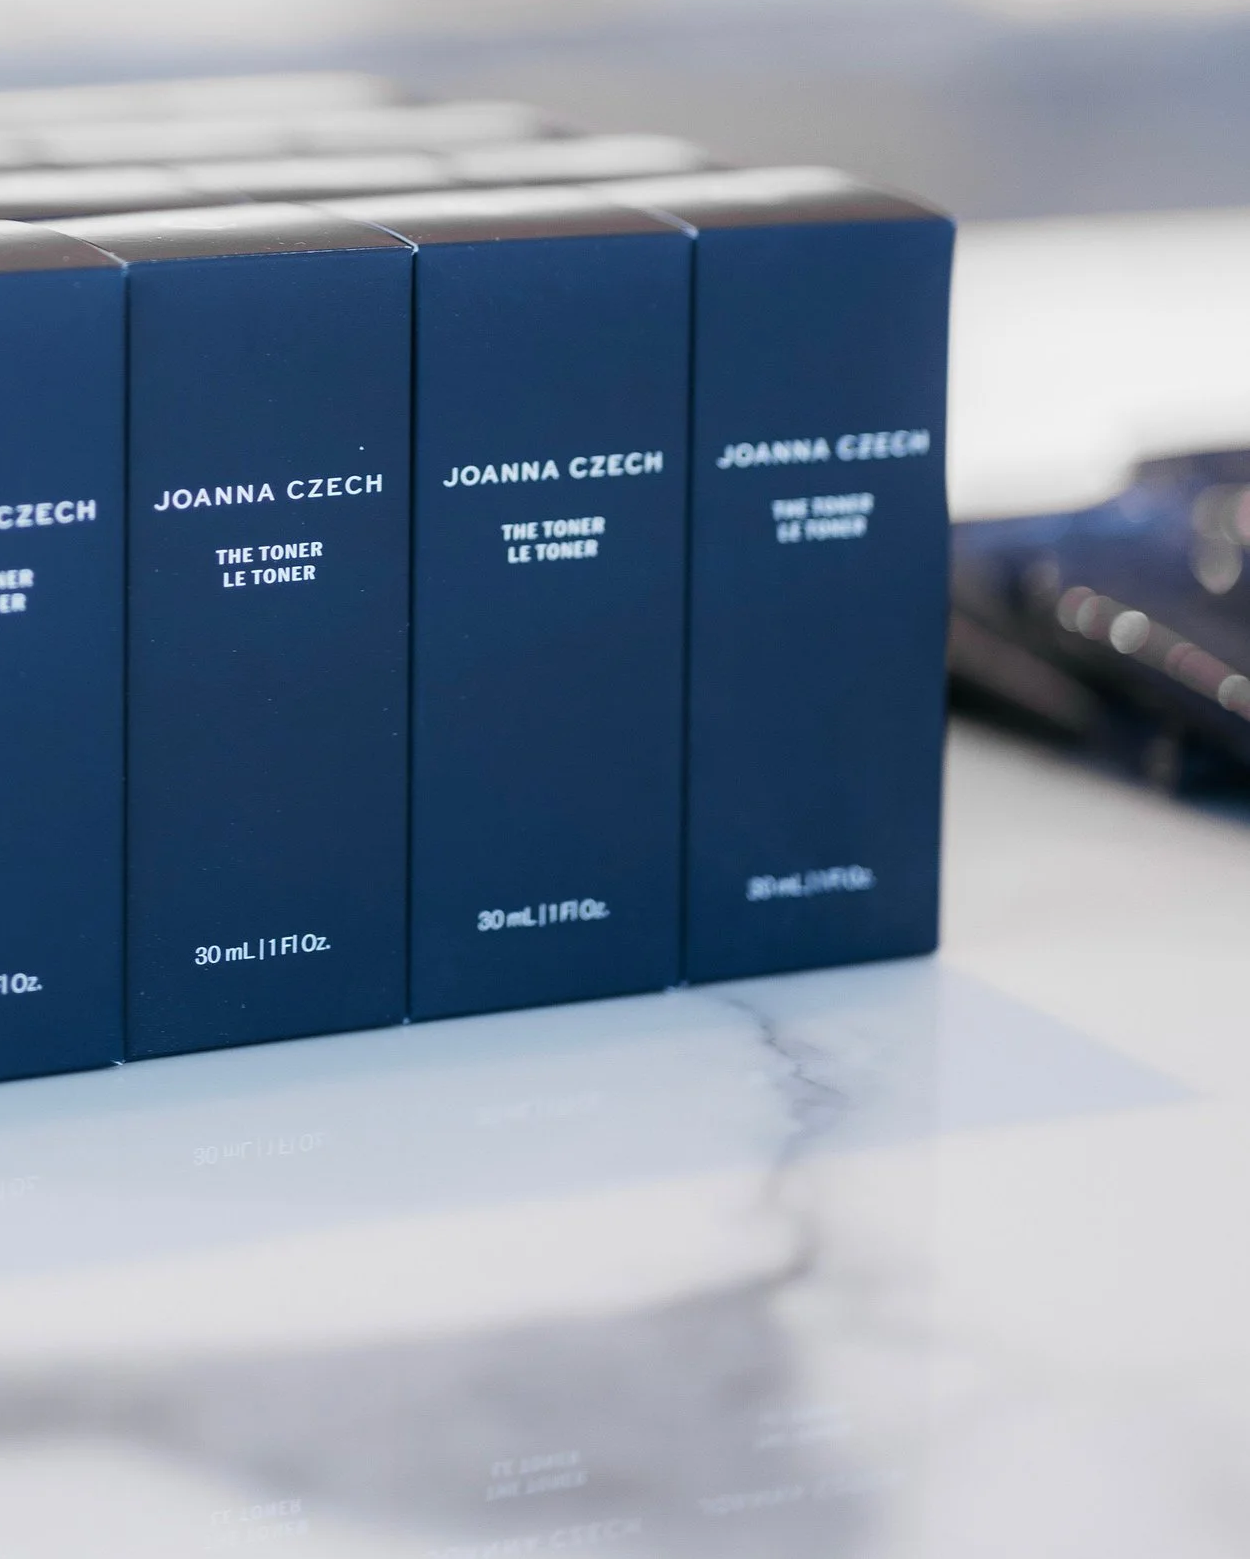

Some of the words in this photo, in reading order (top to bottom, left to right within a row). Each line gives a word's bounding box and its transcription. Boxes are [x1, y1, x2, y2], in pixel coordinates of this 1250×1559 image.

[716, 437, 831, 469] JOANNA
[442, 460, 560, 488] JOANNA
[569, 450, 663, 479] CZECH
[153, 483, 276, 511] JOANNA
[287, 474, 384, 500] CZECH
[500, 521, 539, 542] THE
[541, 516, 606, 539] TONER
[215, 546, 254, 565] THE
[258, 541, 324, 562] TONER
[508, 544, 532, 565] LE
[534, 539, 600, 561] TONER
[223, 570, 247, 589] LE
[251, 565, 317, 586] TONER
[477, 908, 505, 932] 30
[506, 905, 537, 928] mL
[194, 945, 222, 966] 30
[225, 942, 256, 962] mL
[268, 938, 276, 957] 1
[281, 934, 298, 955] Fl
[301, 933, 331, 953] Oz.
[10, 973, 43, 994] Oz.
